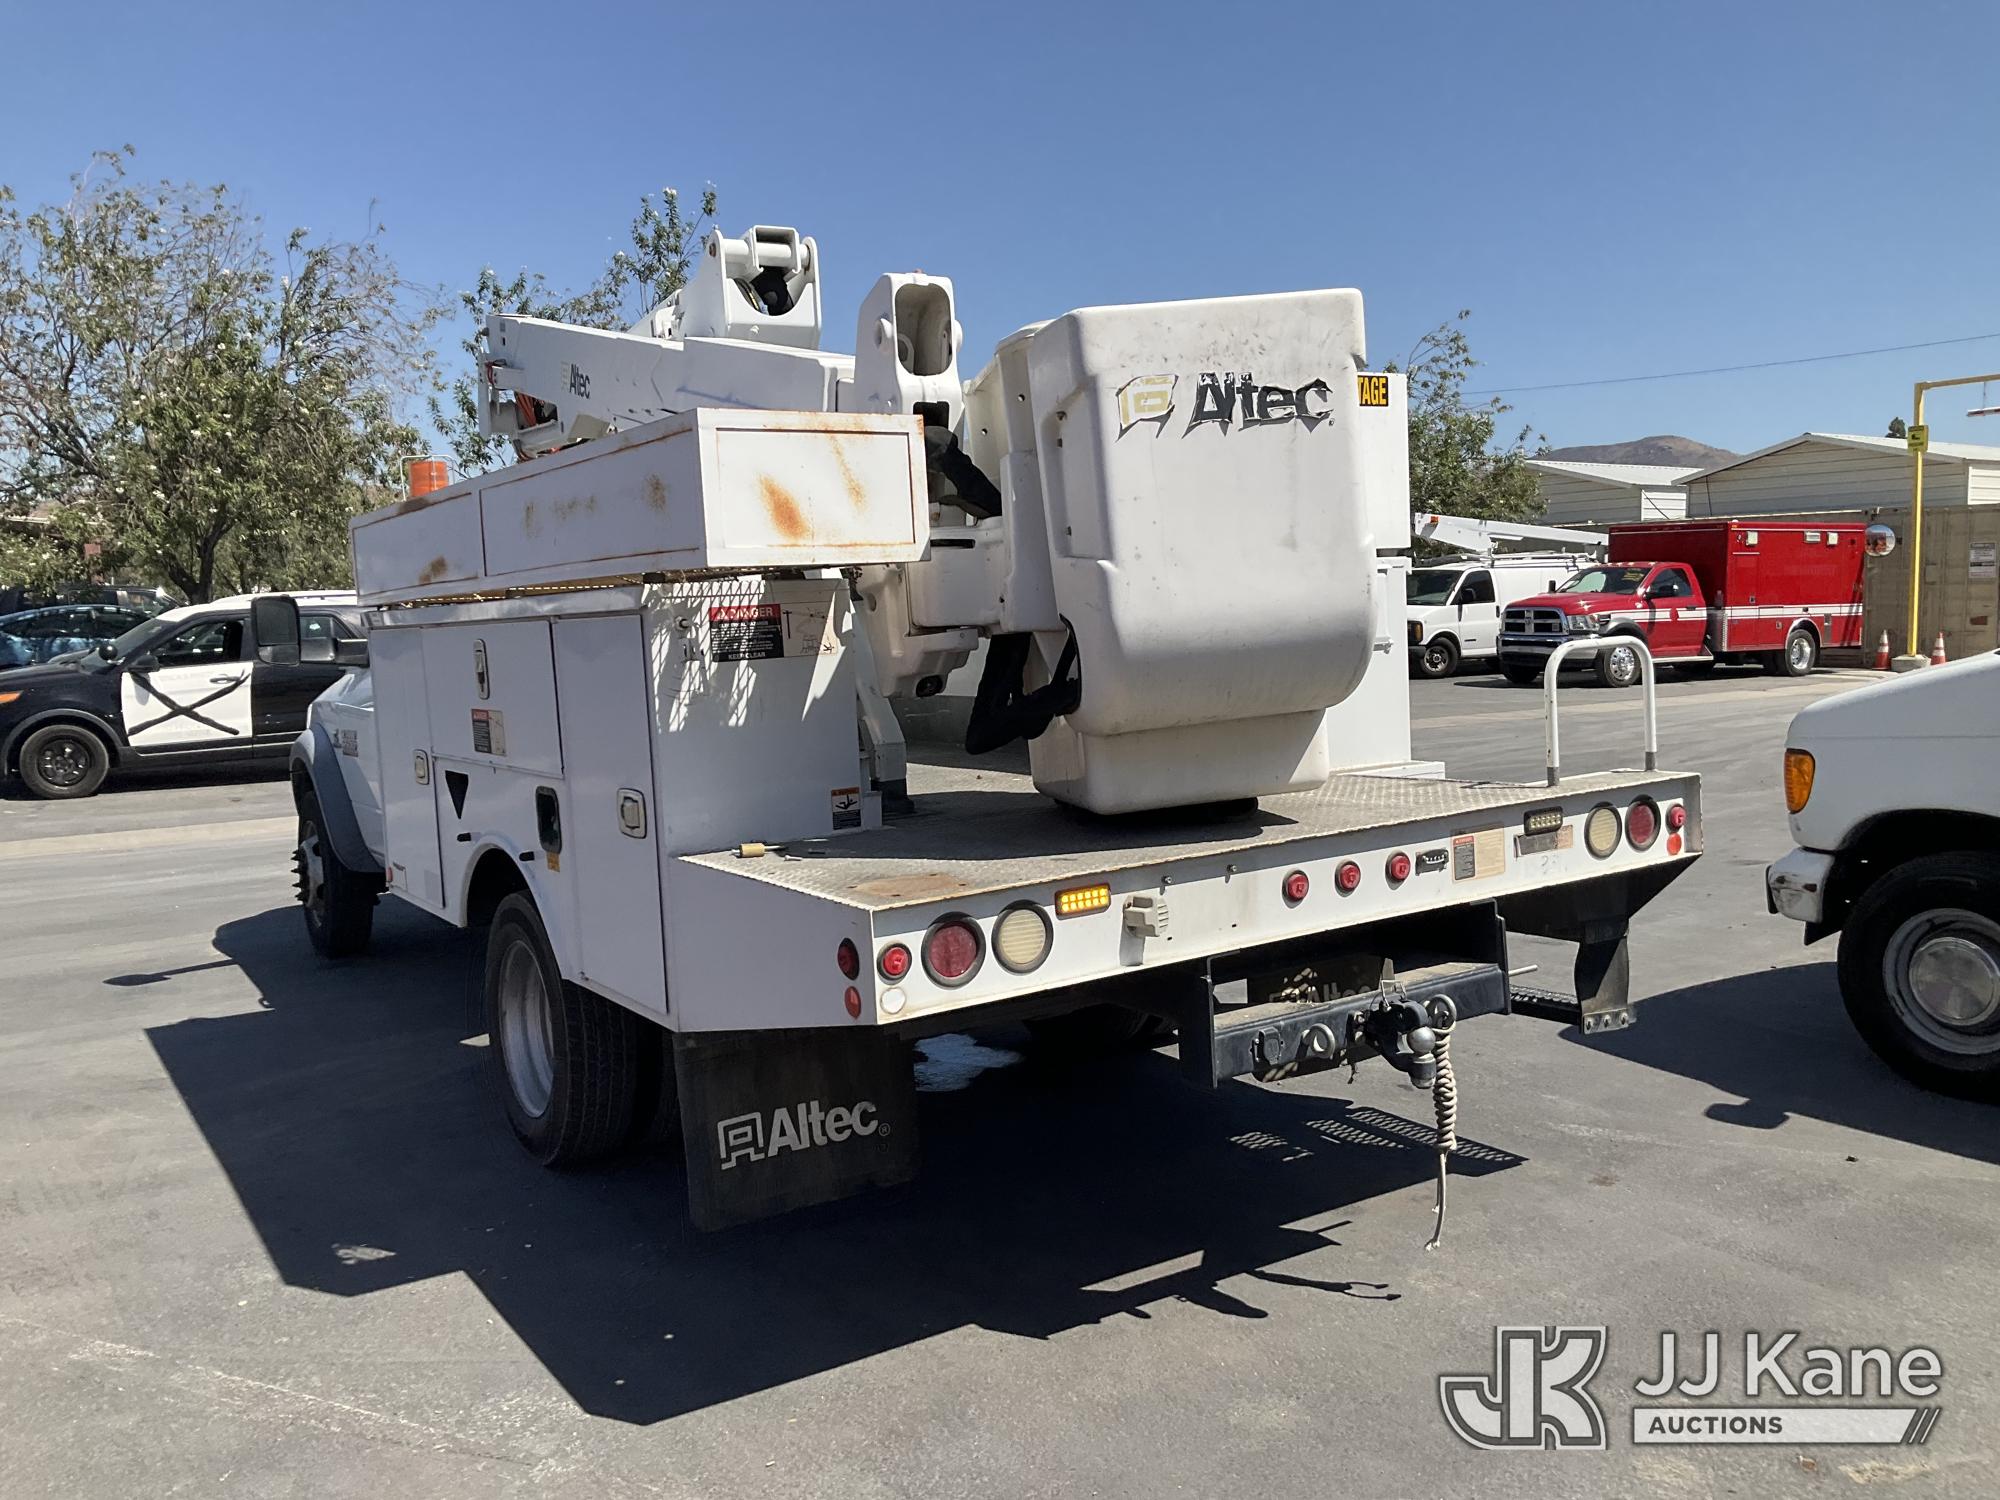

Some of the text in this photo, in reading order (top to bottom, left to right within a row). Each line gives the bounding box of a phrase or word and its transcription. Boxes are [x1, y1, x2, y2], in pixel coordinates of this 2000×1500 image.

[569, 363, 591, 399] Altec
[729, 607, 773, 619] DANGER
[768, 1100, 879, 1157] Altec
